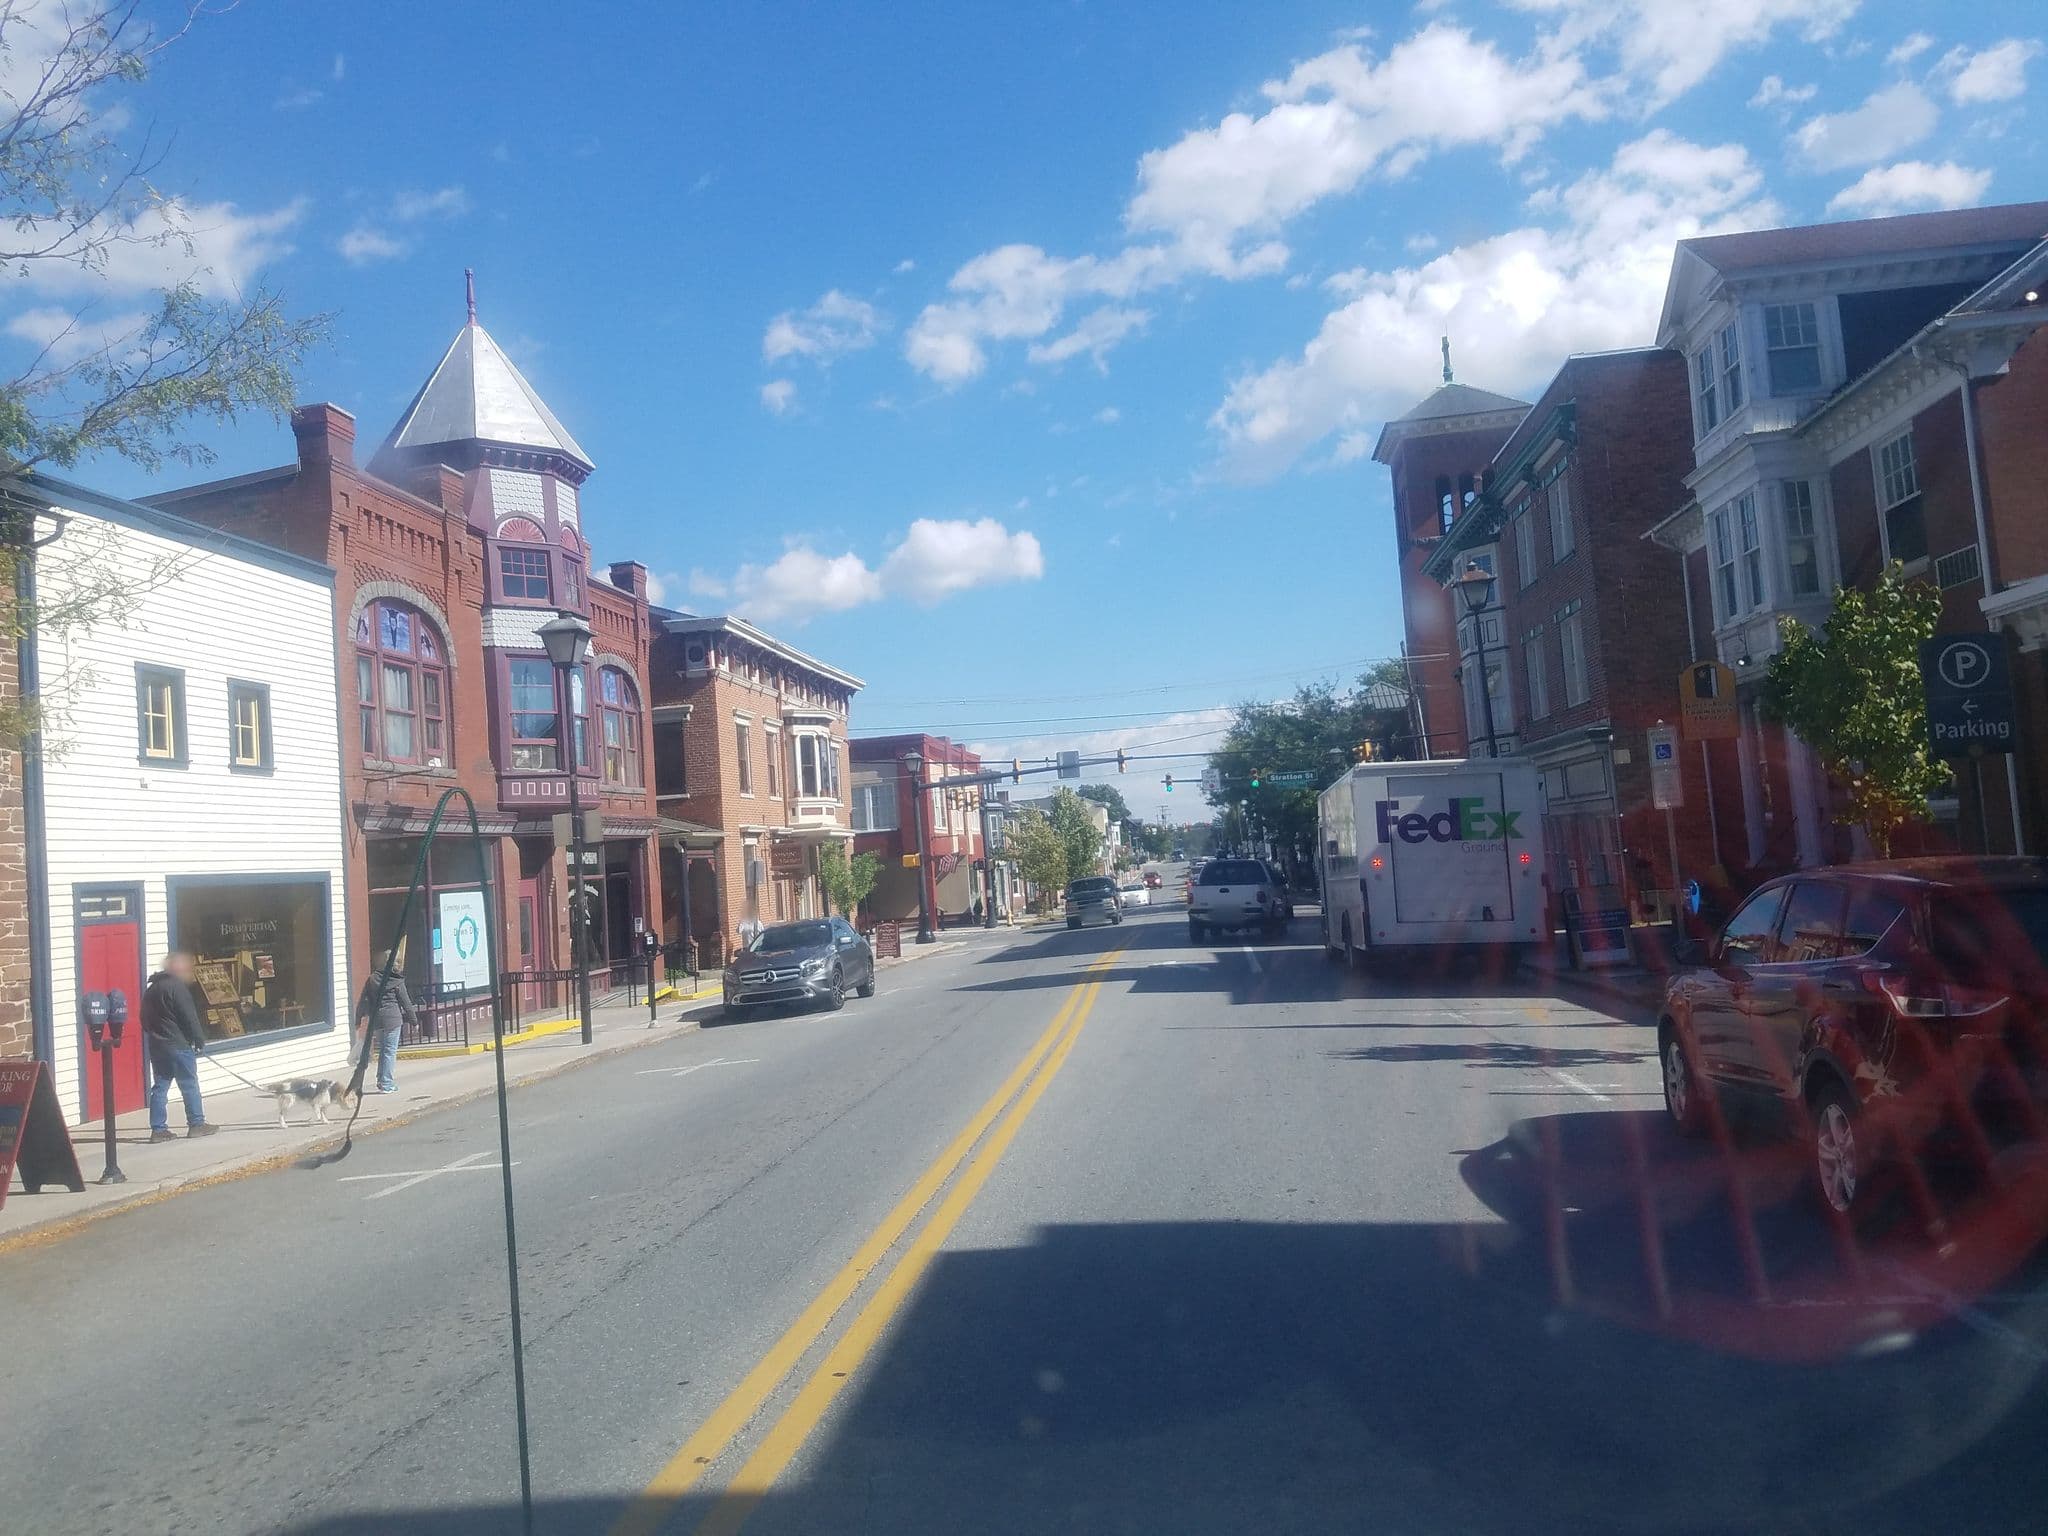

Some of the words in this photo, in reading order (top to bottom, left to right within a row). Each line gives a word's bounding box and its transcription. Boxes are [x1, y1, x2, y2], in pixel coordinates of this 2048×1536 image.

[1955, 651, 1977, 680] P
[1935, 719, 2010, 739] Parking
[1270, 773, 1303, 781] Stratton
[1376, 797, 1525, 843] FedEx
[1461, 841, 1506, 854] Ground
